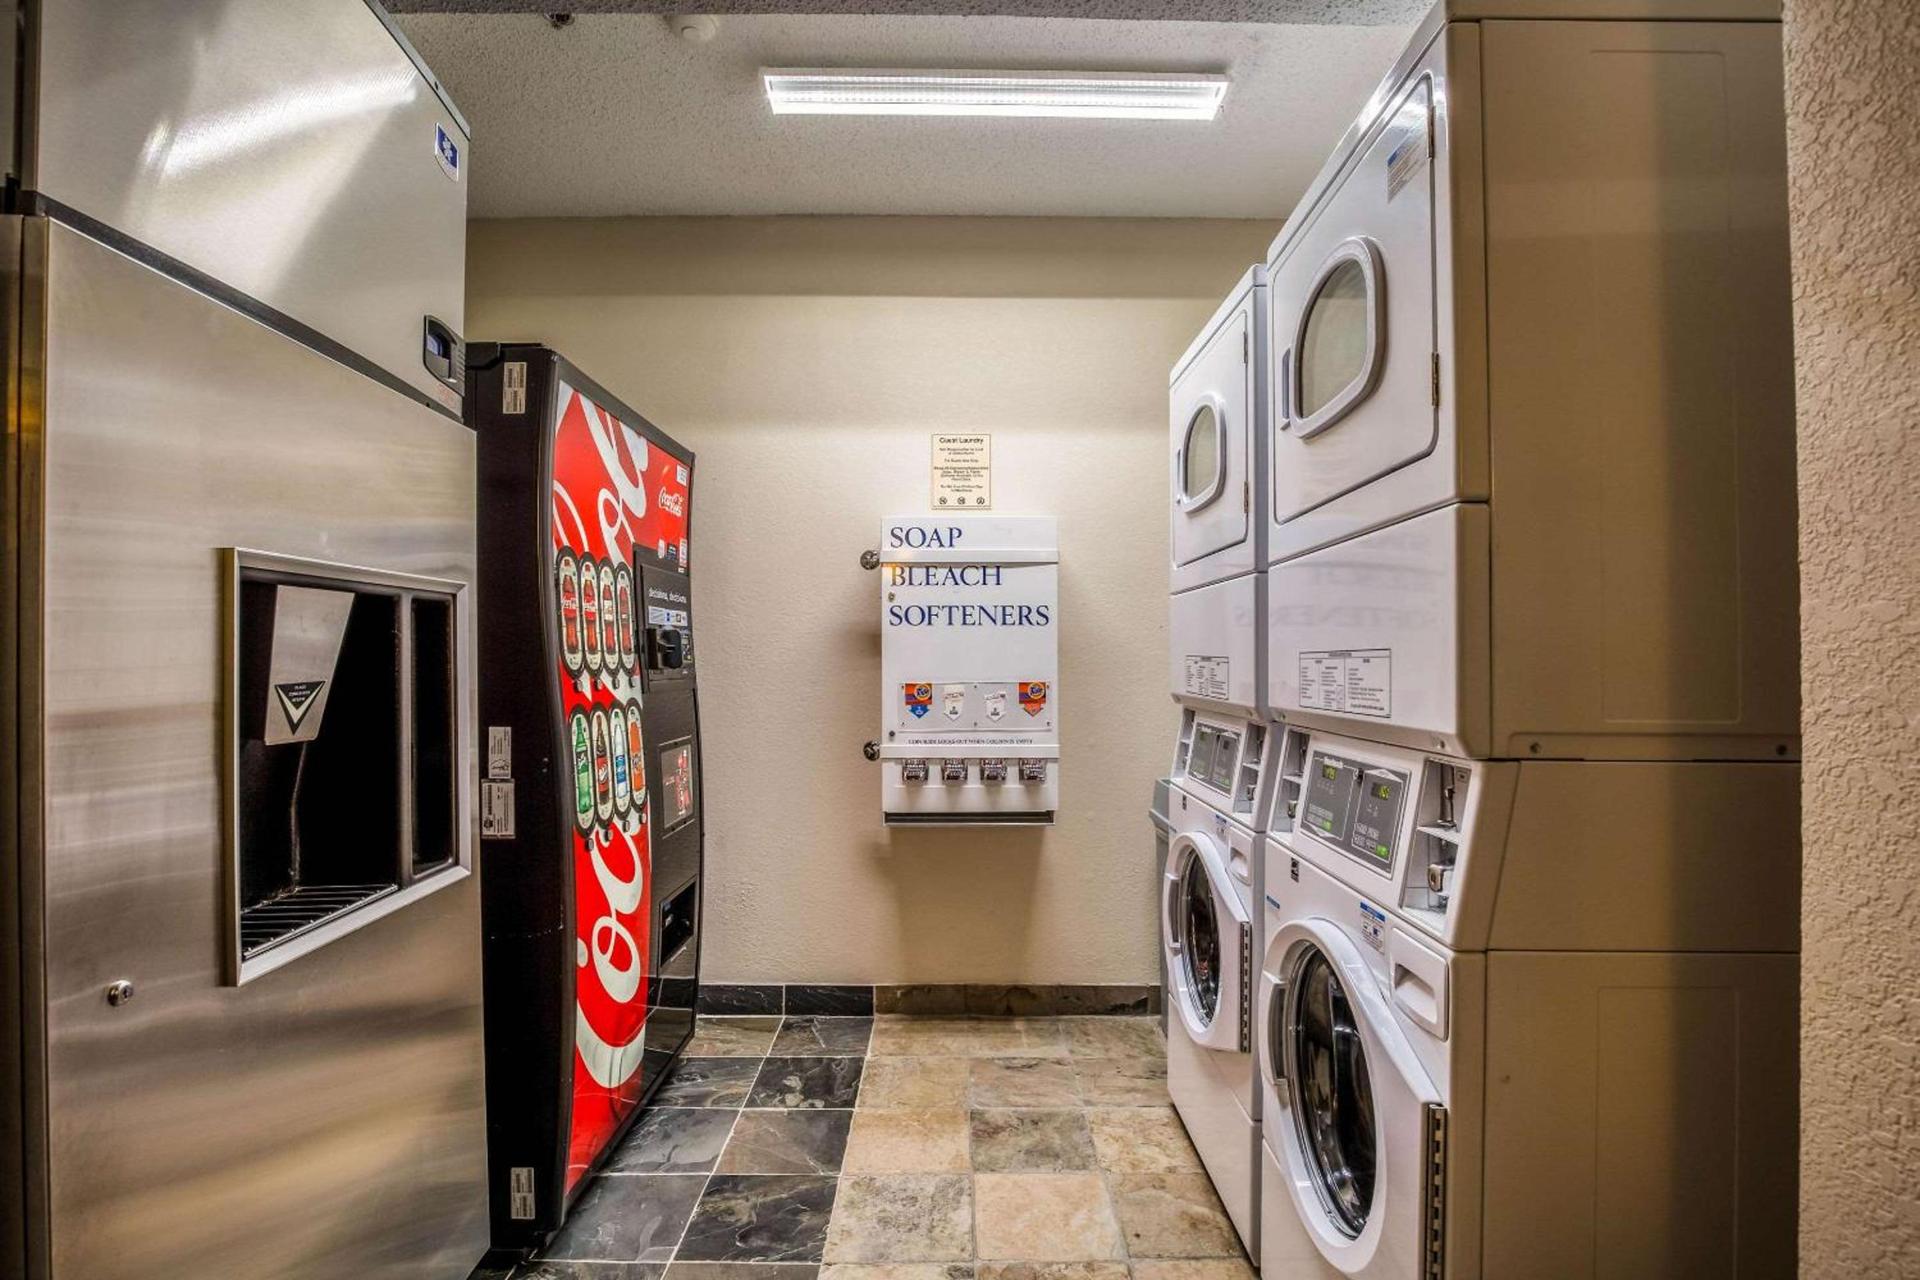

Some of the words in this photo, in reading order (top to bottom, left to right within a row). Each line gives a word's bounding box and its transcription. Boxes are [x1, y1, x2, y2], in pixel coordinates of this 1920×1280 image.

[959, 437, 984, 445] Laundry
[890, 526, 962, 549] SOAP
[891, 565, 1003, 587] BLEACH
[889, 604, 1050, 627] SOFTENERS
